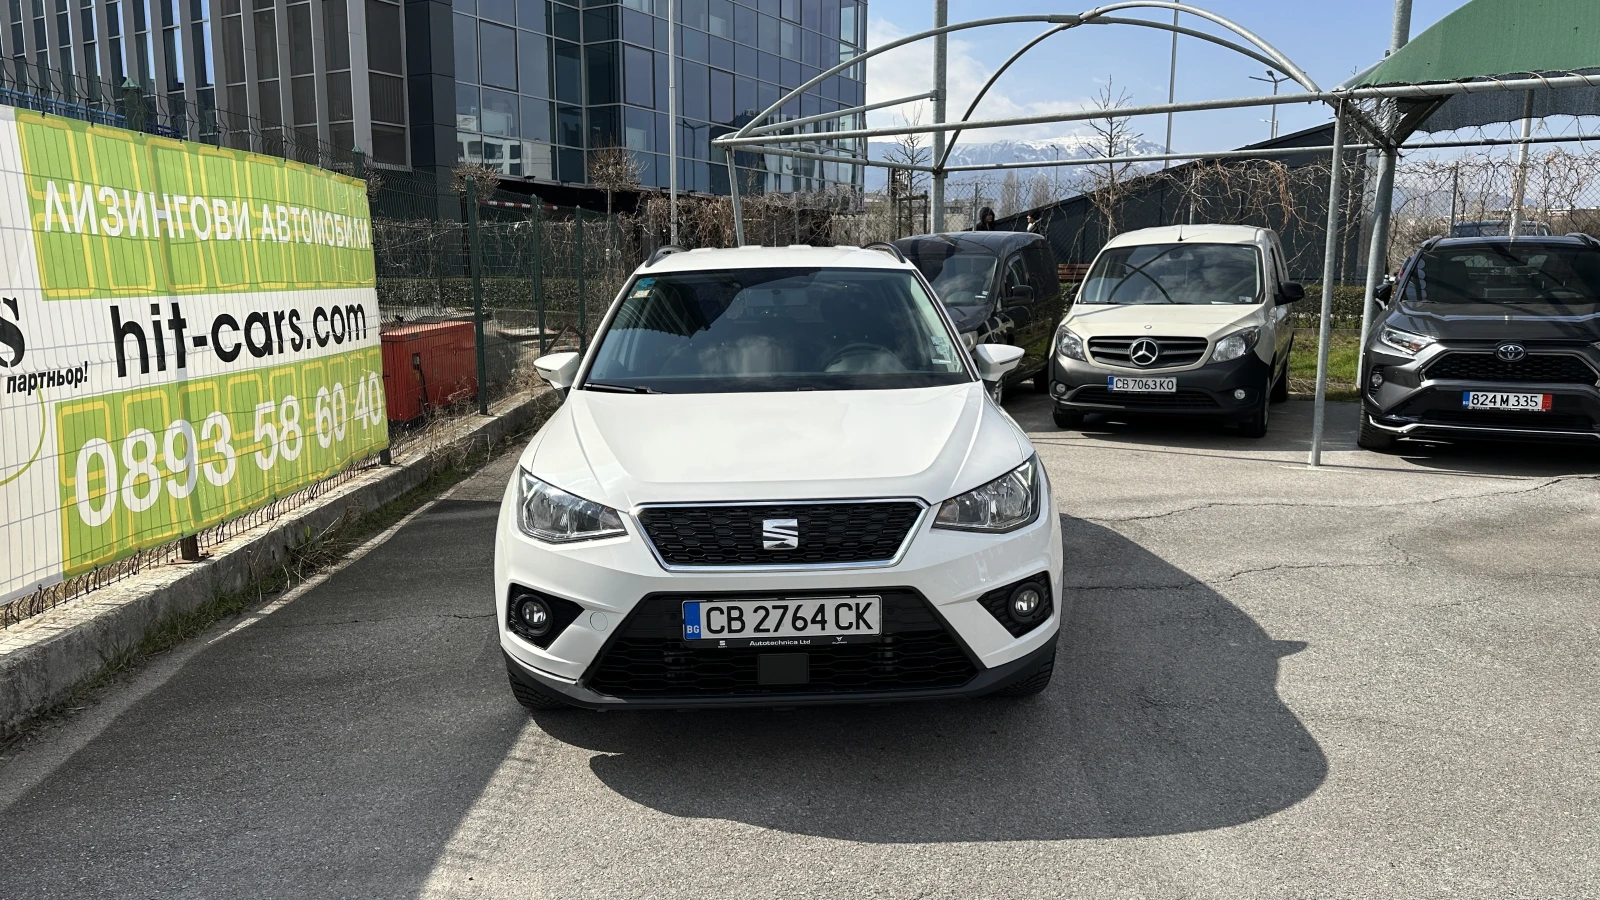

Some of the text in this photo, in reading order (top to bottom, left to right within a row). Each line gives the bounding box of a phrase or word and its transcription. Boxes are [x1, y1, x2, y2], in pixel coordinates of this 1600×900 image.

[44, 181, 370, 249] ЛИЗИНГОВИ АВТОМОБИЛИ
[110, 302, 367, 378] hit-cars.com
[7, 361, 88, 396] партньор!
[1115, 379, 1129, 389] CB
[1131, 380, 1157, 390] 7063
[1471, 394, 1497, 406] 824
[1500, 395, 1509, 407] M
[1512, 395, 1538, 407] 335
[75, 371, 383, 527] 0893 58 60 40
[687, 625, 699, 634] BG
[706, 602, 873, 634] CB 2764 CK
[750, 639, 798, 647] Autotechnica
